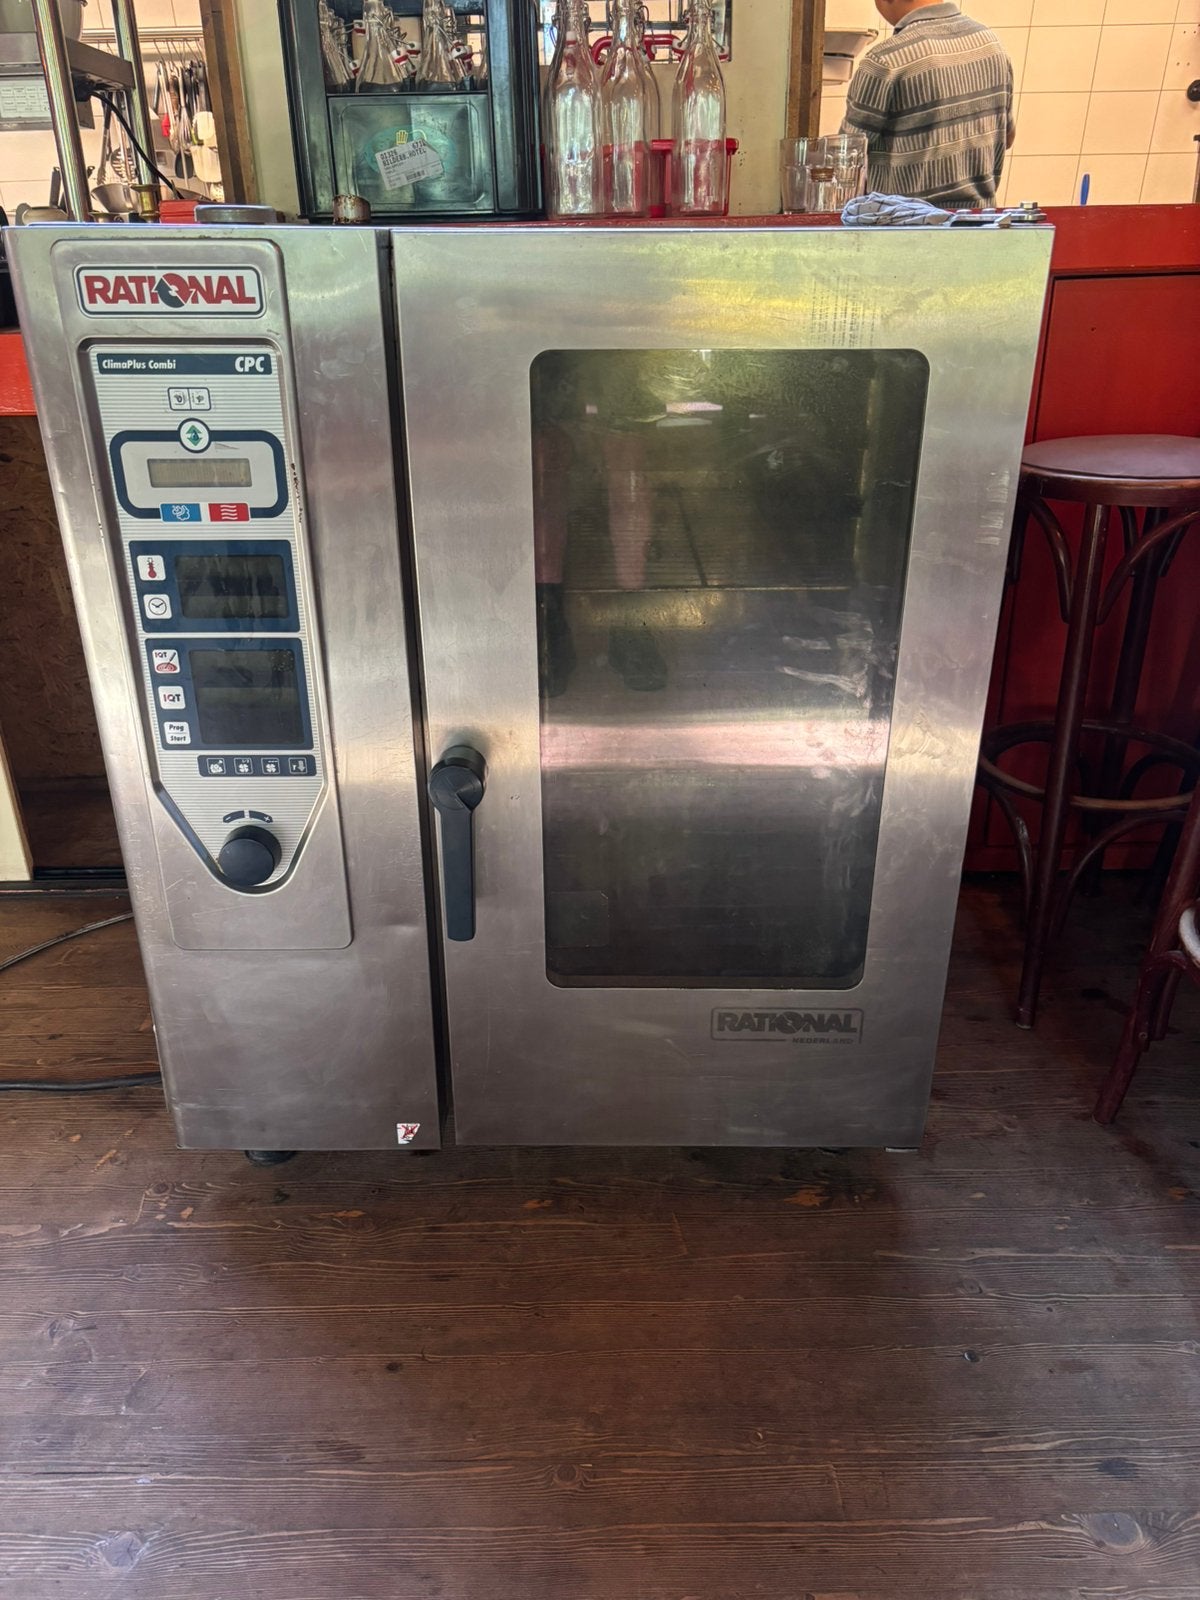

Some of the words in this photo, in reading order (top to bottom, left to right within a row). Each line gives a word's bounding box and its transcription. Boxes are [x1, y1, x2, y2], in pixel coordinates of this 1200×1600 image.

[84, 273, 256, 308] RATIONAL
[102, 359, 146, 370] ClimaPlus
[148, 359, 177, 370] Combi
[234, 356, 265, 373] CPC
[163, 694, 181, 703] IQT
[168, 724, 185, 732] Prog
[717, 1011, 857, 1034] RATIONAL
